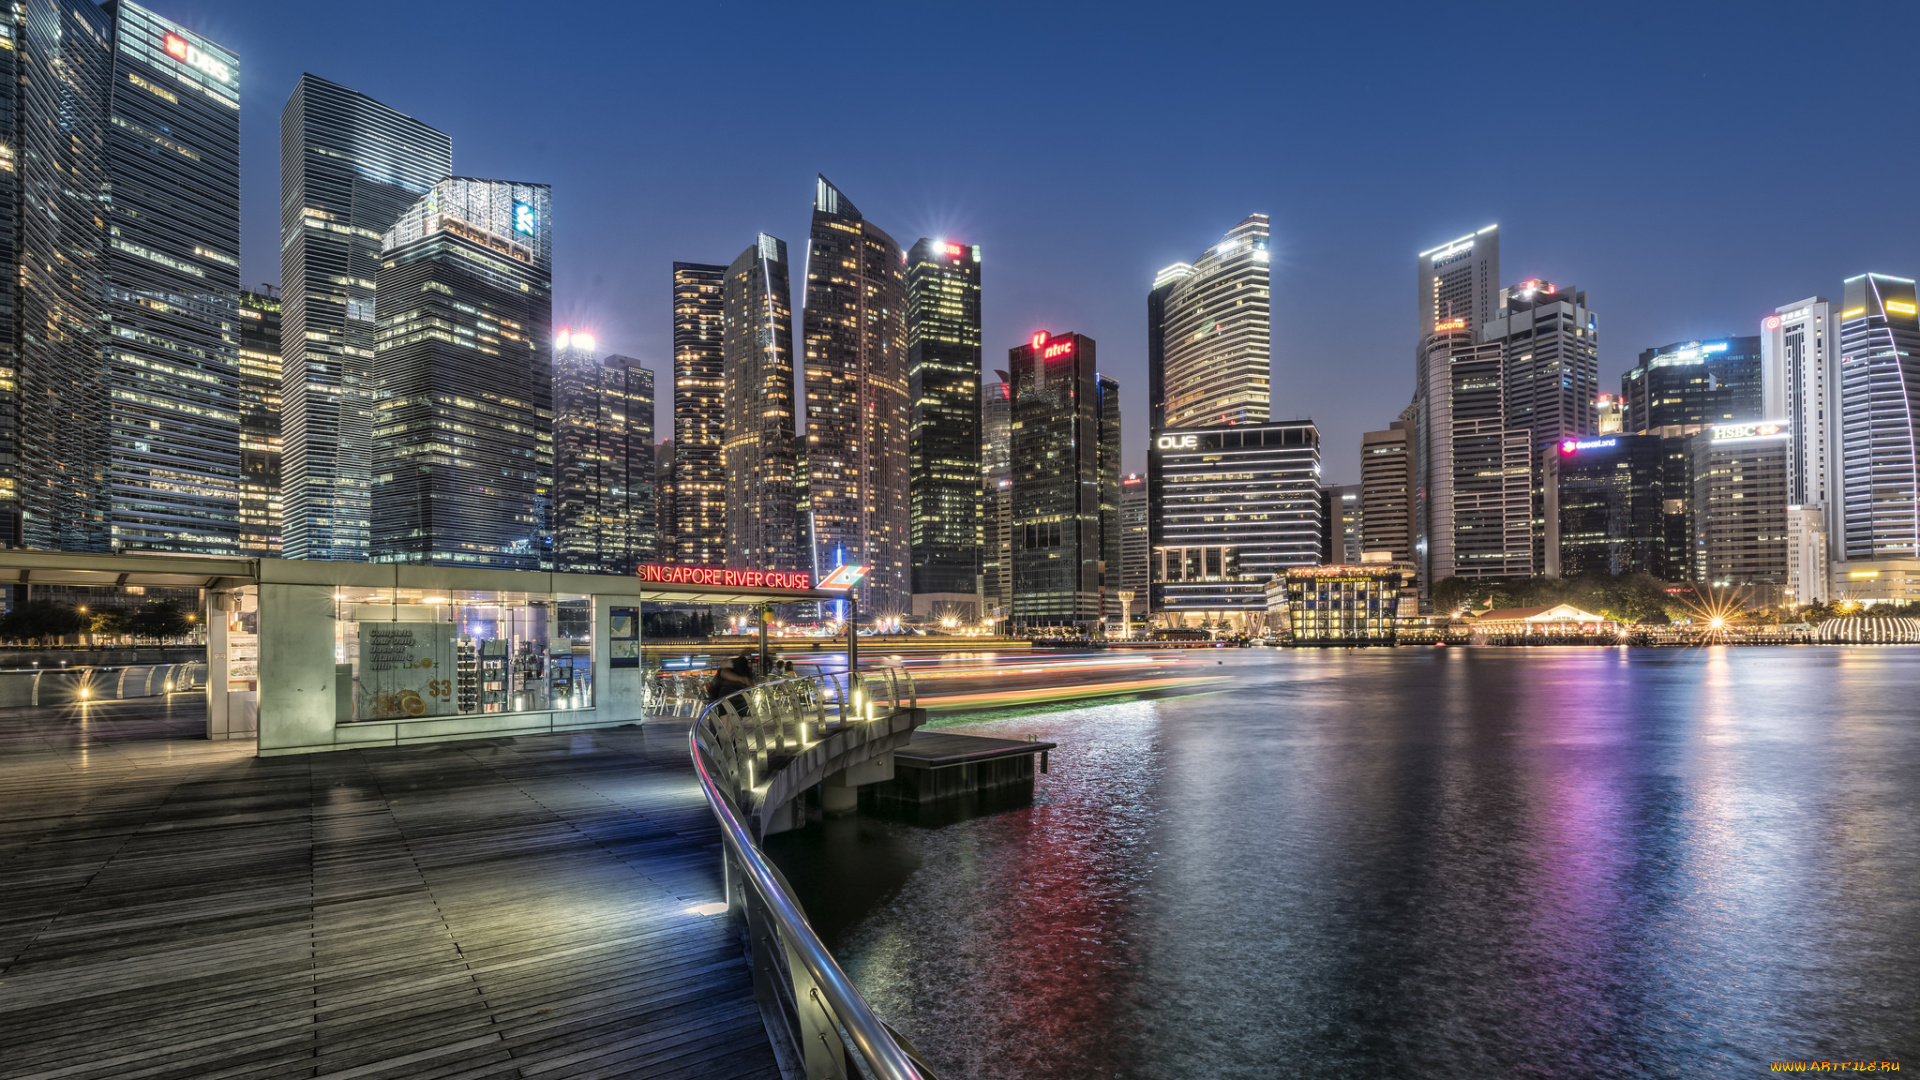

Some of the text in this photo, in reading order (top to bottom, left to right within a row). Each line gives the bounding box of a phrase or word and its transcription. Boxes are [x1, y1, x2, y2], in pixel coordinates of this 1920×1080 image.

[185, 44, 230, 82] DBS
[1044, 342, 1072, 359] ntuc
[1714, 425, 1756, 440] HSBC
[1158, 435, 1198, 450] OUE
[637, 564, 810, 589] SINGAPORE RIVER CRUISE
[370, 645, 392, 653] Dose
[371, 637, 416, 647] Your Daily
[370, 653, 404, 662] Vitamin
[429, 679, 452, 698] $3
